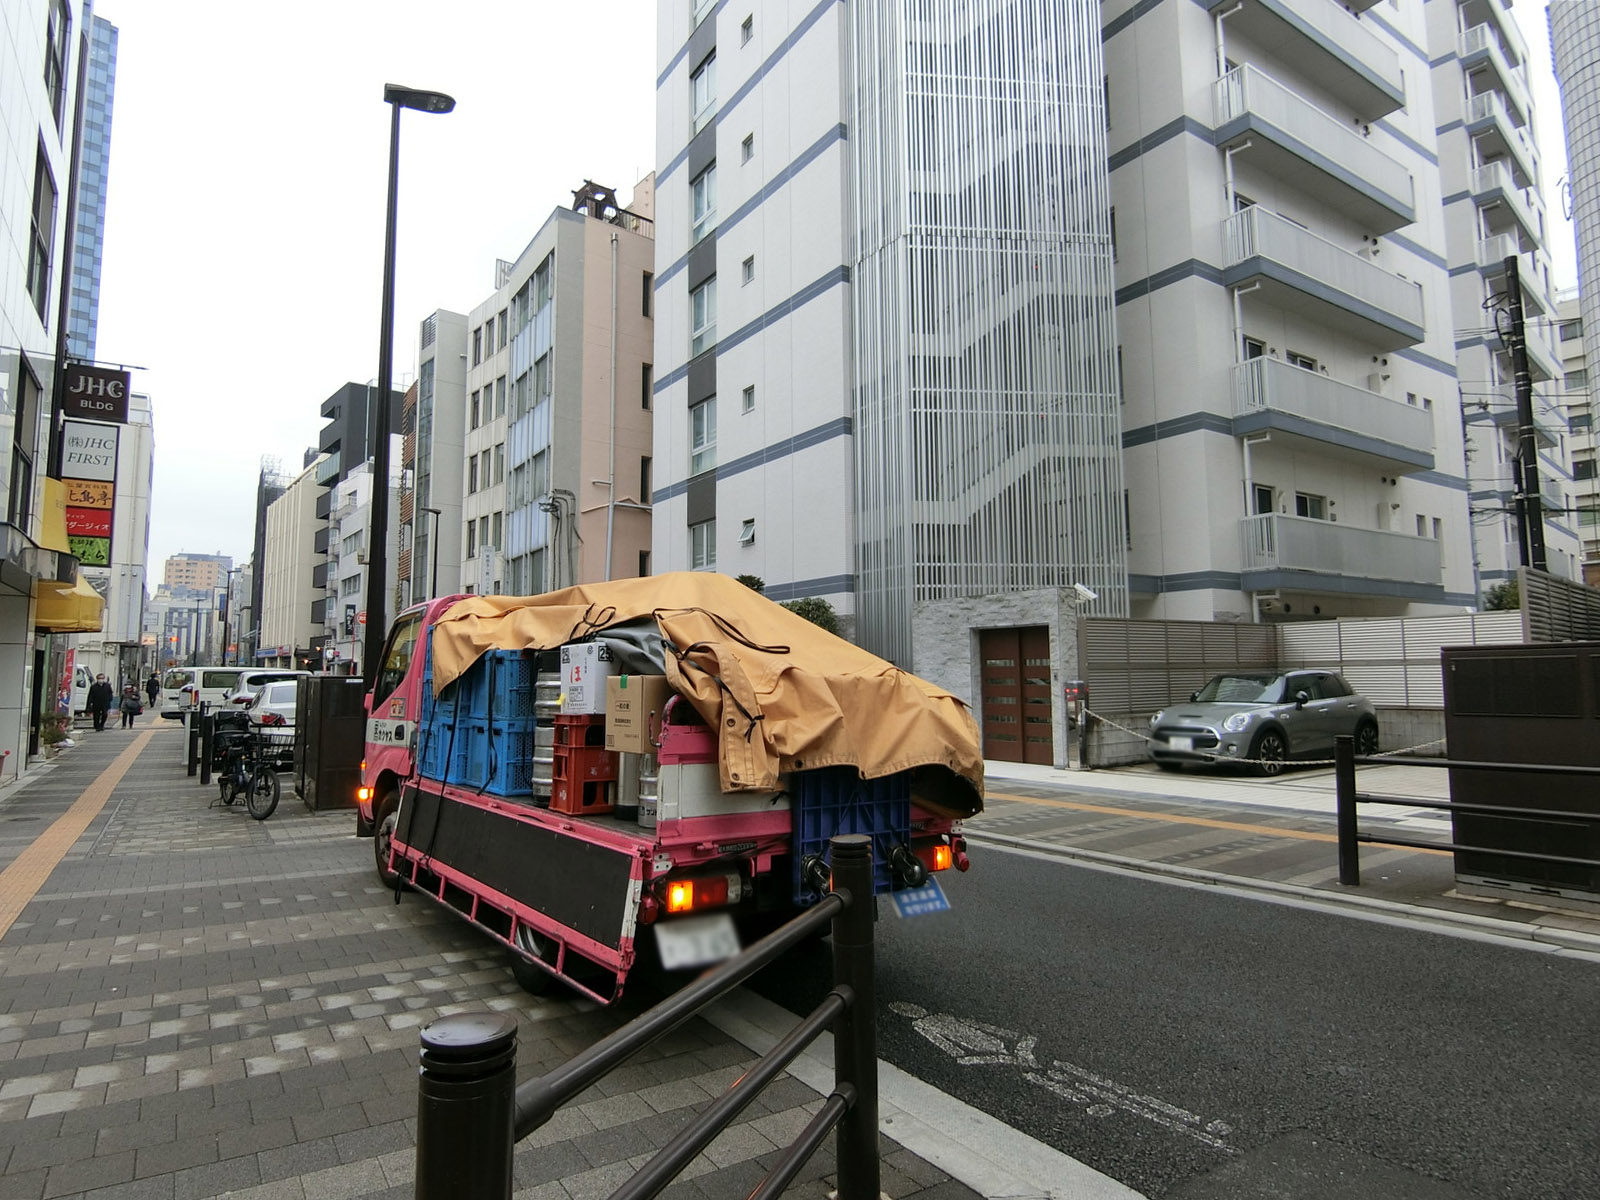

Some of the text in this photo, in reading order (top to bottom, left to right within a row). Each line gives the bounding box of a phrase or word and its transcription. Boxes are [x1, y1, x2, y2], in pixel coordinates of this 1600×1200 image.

[70, 375, 124, 398] JHC
[80, 399, 114, 411] BLDG
[67, 451, 113, 466] FIRST
